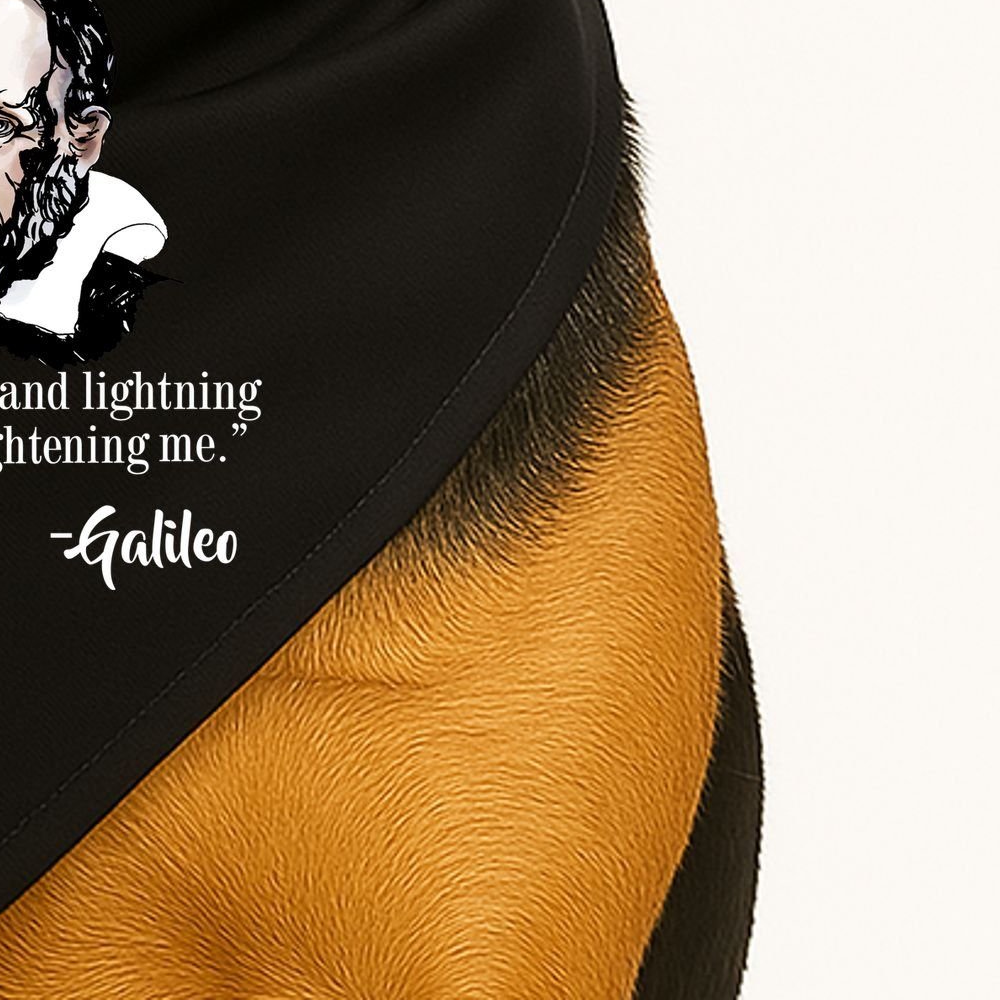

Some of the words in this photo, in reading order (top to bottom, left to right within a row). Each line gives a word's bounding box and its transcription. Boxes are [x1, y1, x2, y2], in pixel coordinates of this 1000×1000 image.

[82, 370, 263, 421] lightning
[158, 422, 248, 463] me.”
[49, 504, 238, 591] -Galileo
